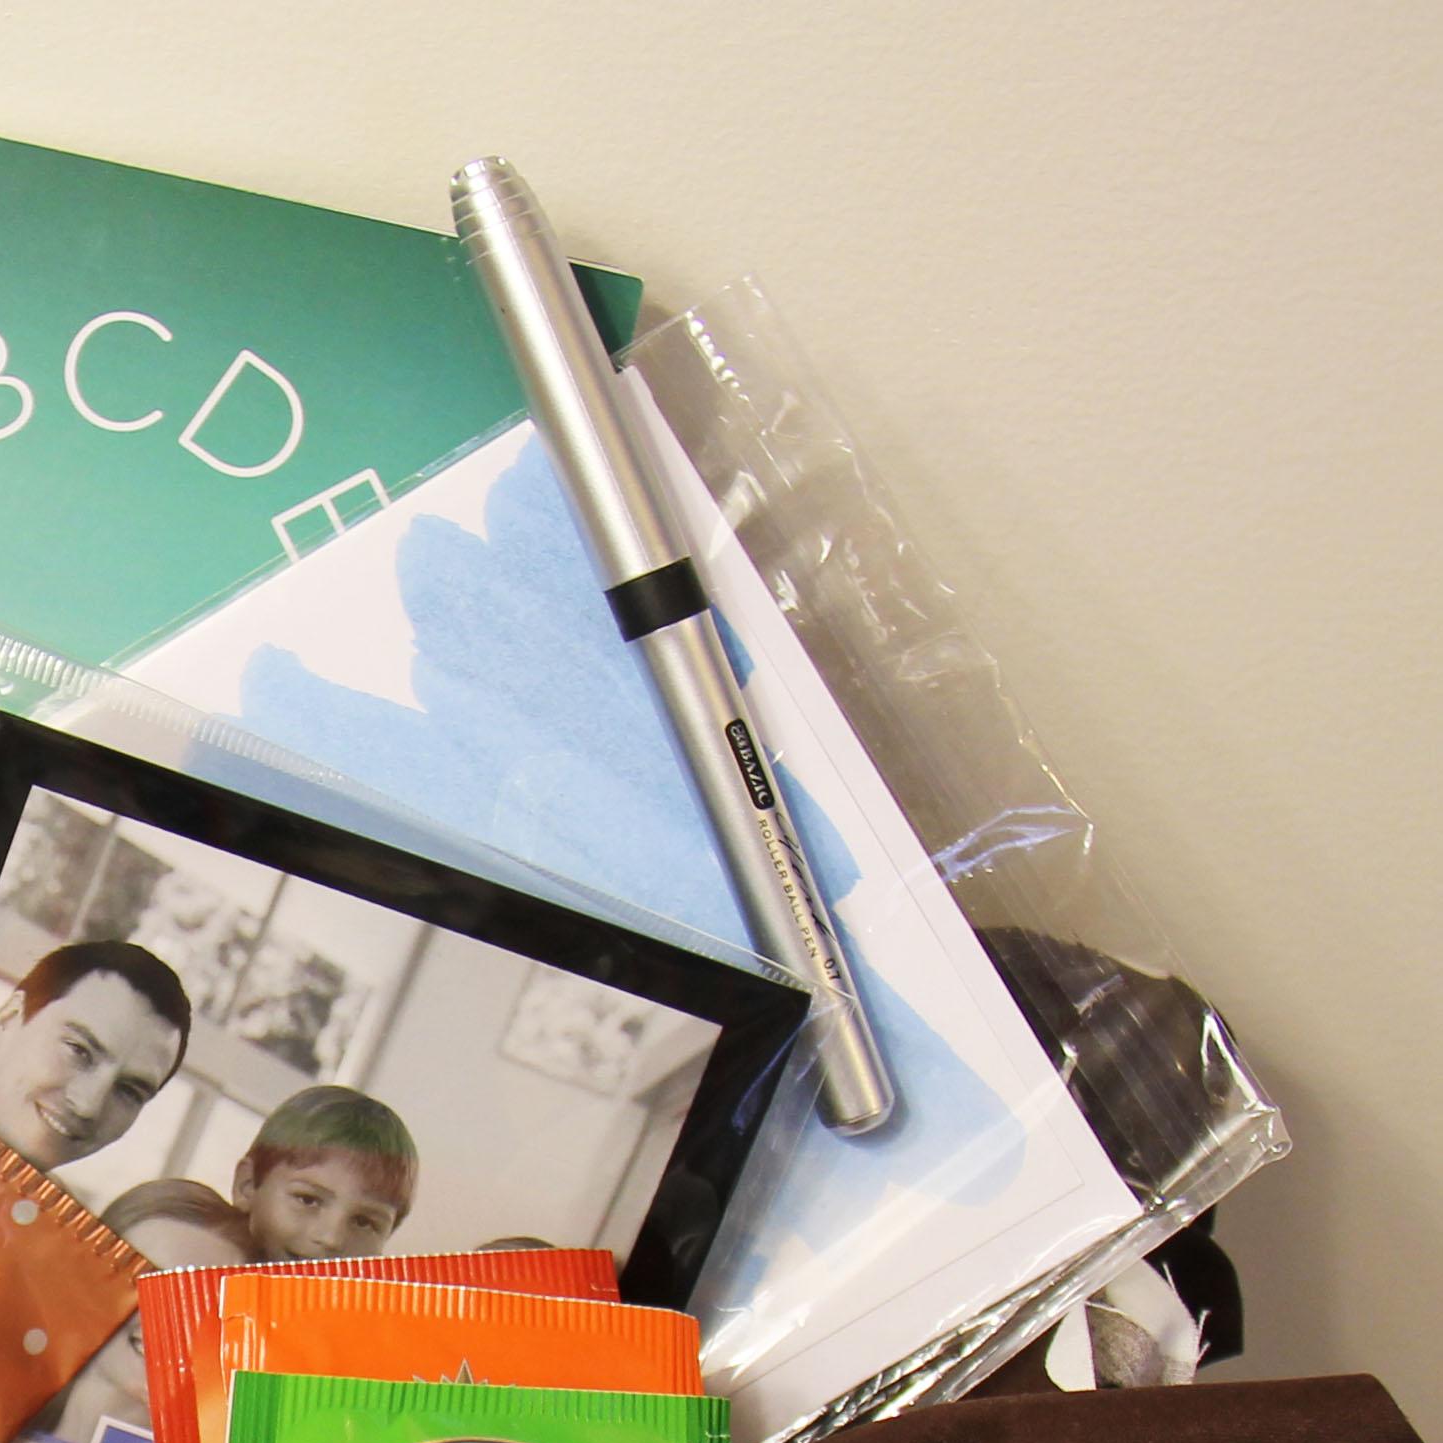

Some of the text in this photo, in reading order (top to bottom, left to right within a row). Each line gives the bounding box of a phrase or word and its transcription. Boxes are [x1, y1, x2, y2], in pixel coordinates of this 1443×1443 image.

[65, 311, 172, 432] C
[179, 349, 304, 478] D
[758, 819, 841, 981] ROLLER BALL PEN 0.7
